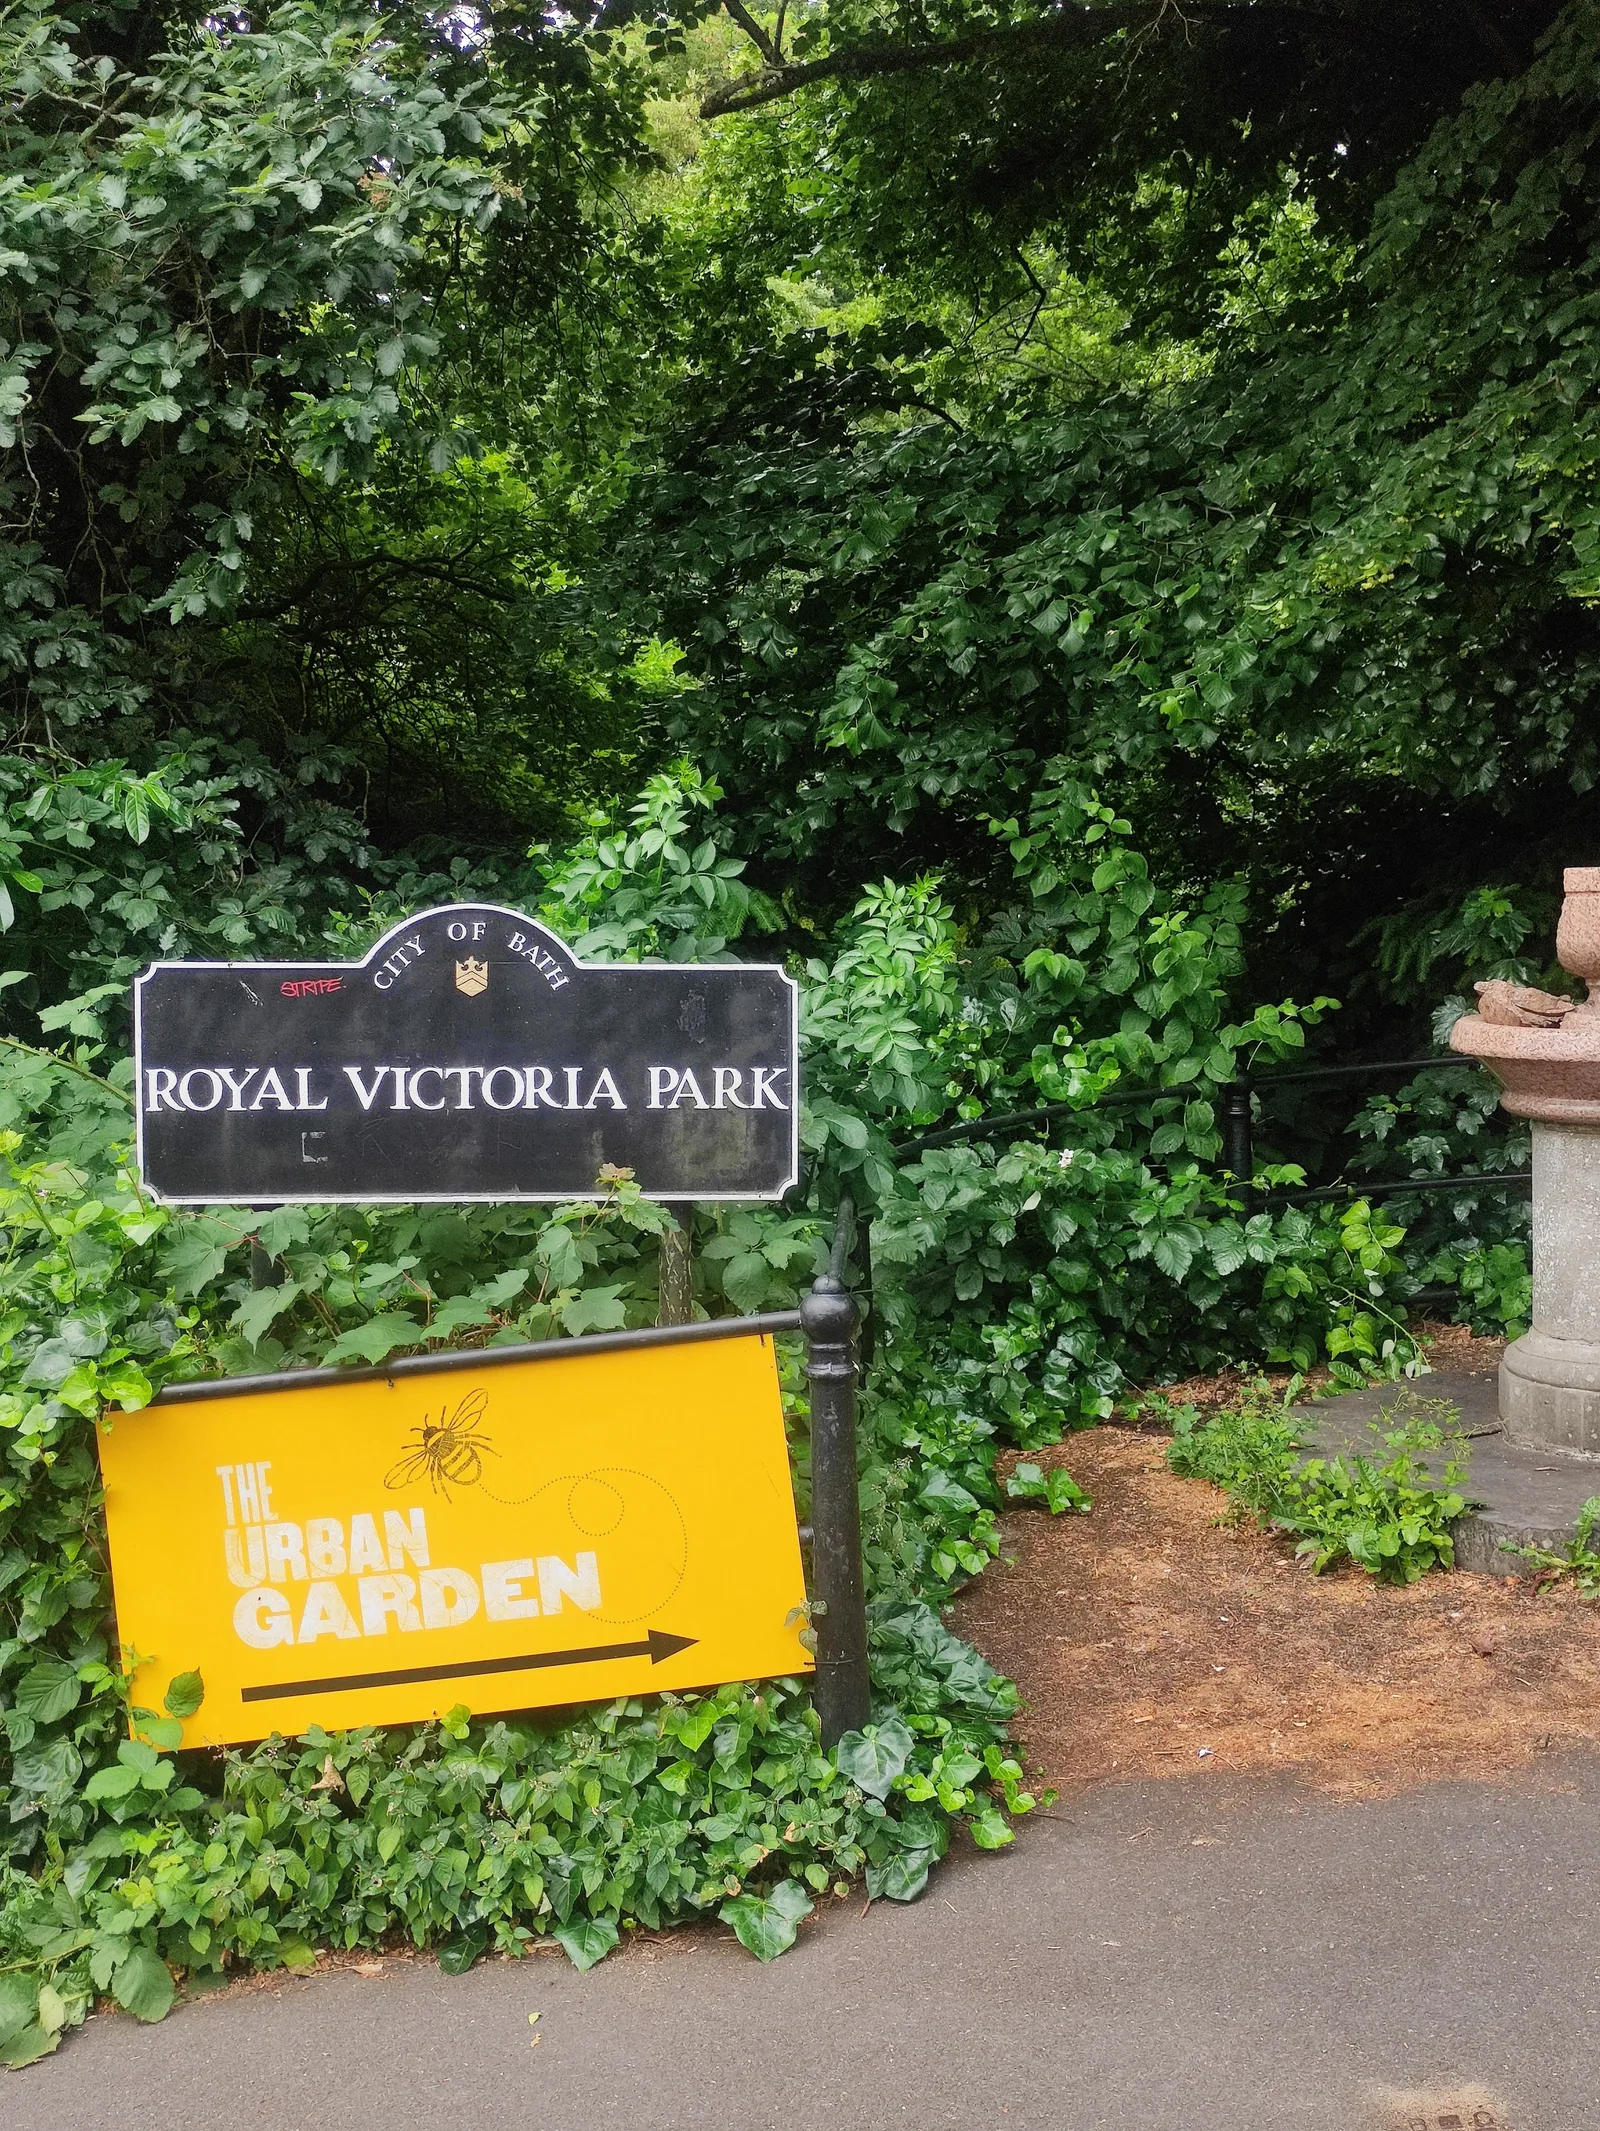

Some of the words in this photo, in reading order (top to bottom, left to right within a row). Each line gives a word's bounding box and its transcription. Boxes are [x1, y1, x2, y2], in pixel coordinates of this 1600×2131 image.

[374, 934, 426, 990] CITY
[448, 922, 487, 942] OF
[507, 931, 570, 991] BATH
[145, 1066, 329, 1112] ROYAL
[342, 1066, 627, 1111] VICTORIA
[646, 1066, 790, 1111] PARK
[216, 1460, 278, 1526] THE
[223, 1506, 430, 1588] URBAN
[233, 1550, 603, 1649] GARDEN
